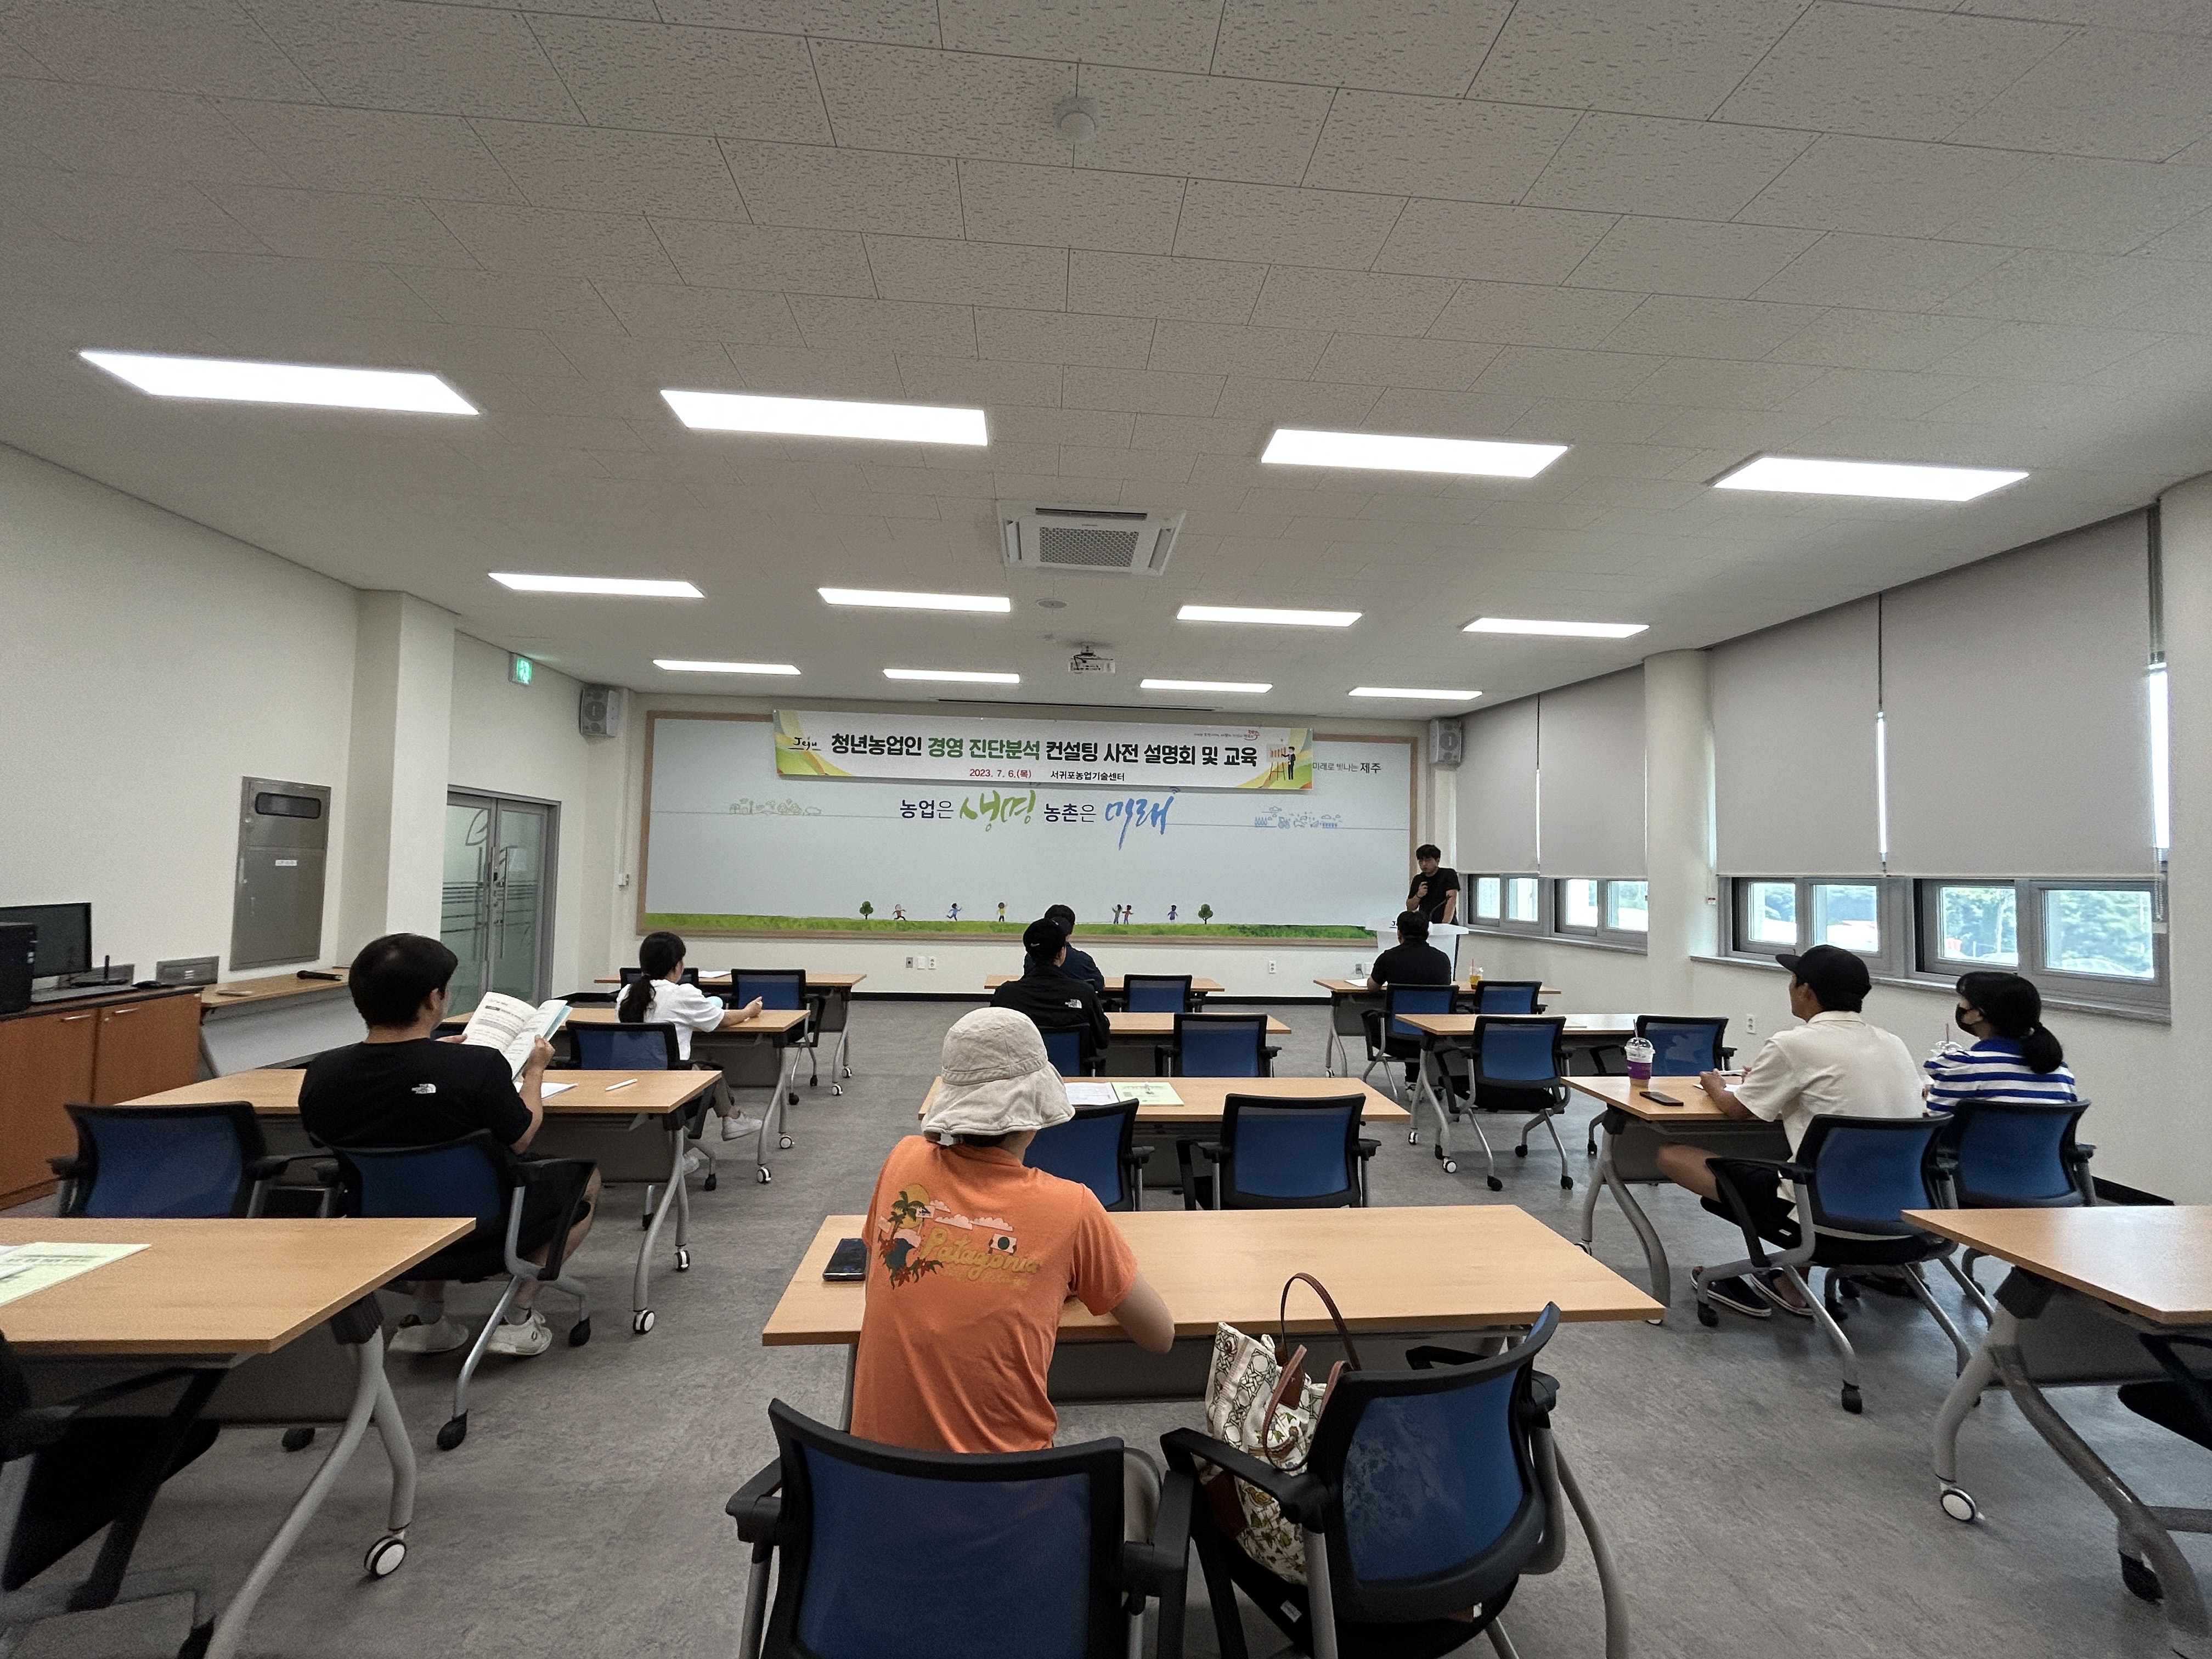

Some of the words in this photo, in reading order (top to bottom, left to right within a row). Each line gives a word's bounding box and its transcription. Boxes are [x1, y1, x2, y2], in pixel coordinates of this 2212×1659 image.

[793, 737, 817, 751] Jeju
[831, 733, 922, 757] 청년농업인
[928, 737, 963, 758] 경영
[969, 739, 1040, 760] 진단분석
[1046, 741, 1098, 762] 컨설팅
[1103, 743, 1138, 763] 사전
[1144, 744, 1195, 765] 설명회
[1202, 746, 1218, 766] 및
[1224, 747, 1257, 767] 교육
[969, 769, 994, 777] 2023.
[997, 769, 1005, 778] 7.
[1312, 761, 1335, 771] 미래로
[1336, 763, 1358, 772] 빛나는
[1360, 762, 1381, 774] 제주
[1050, 770, 1125, 782] 서귀포농업기술센터
[900, 799, 953, 819] 농업은
[959, 789, 1037, 832] 생명
[1043, 803, 1096, 823] 농촌은
[1105, 795, 1175, 851] 미래
[921, 1228, 1039, 1281] Patagonia
